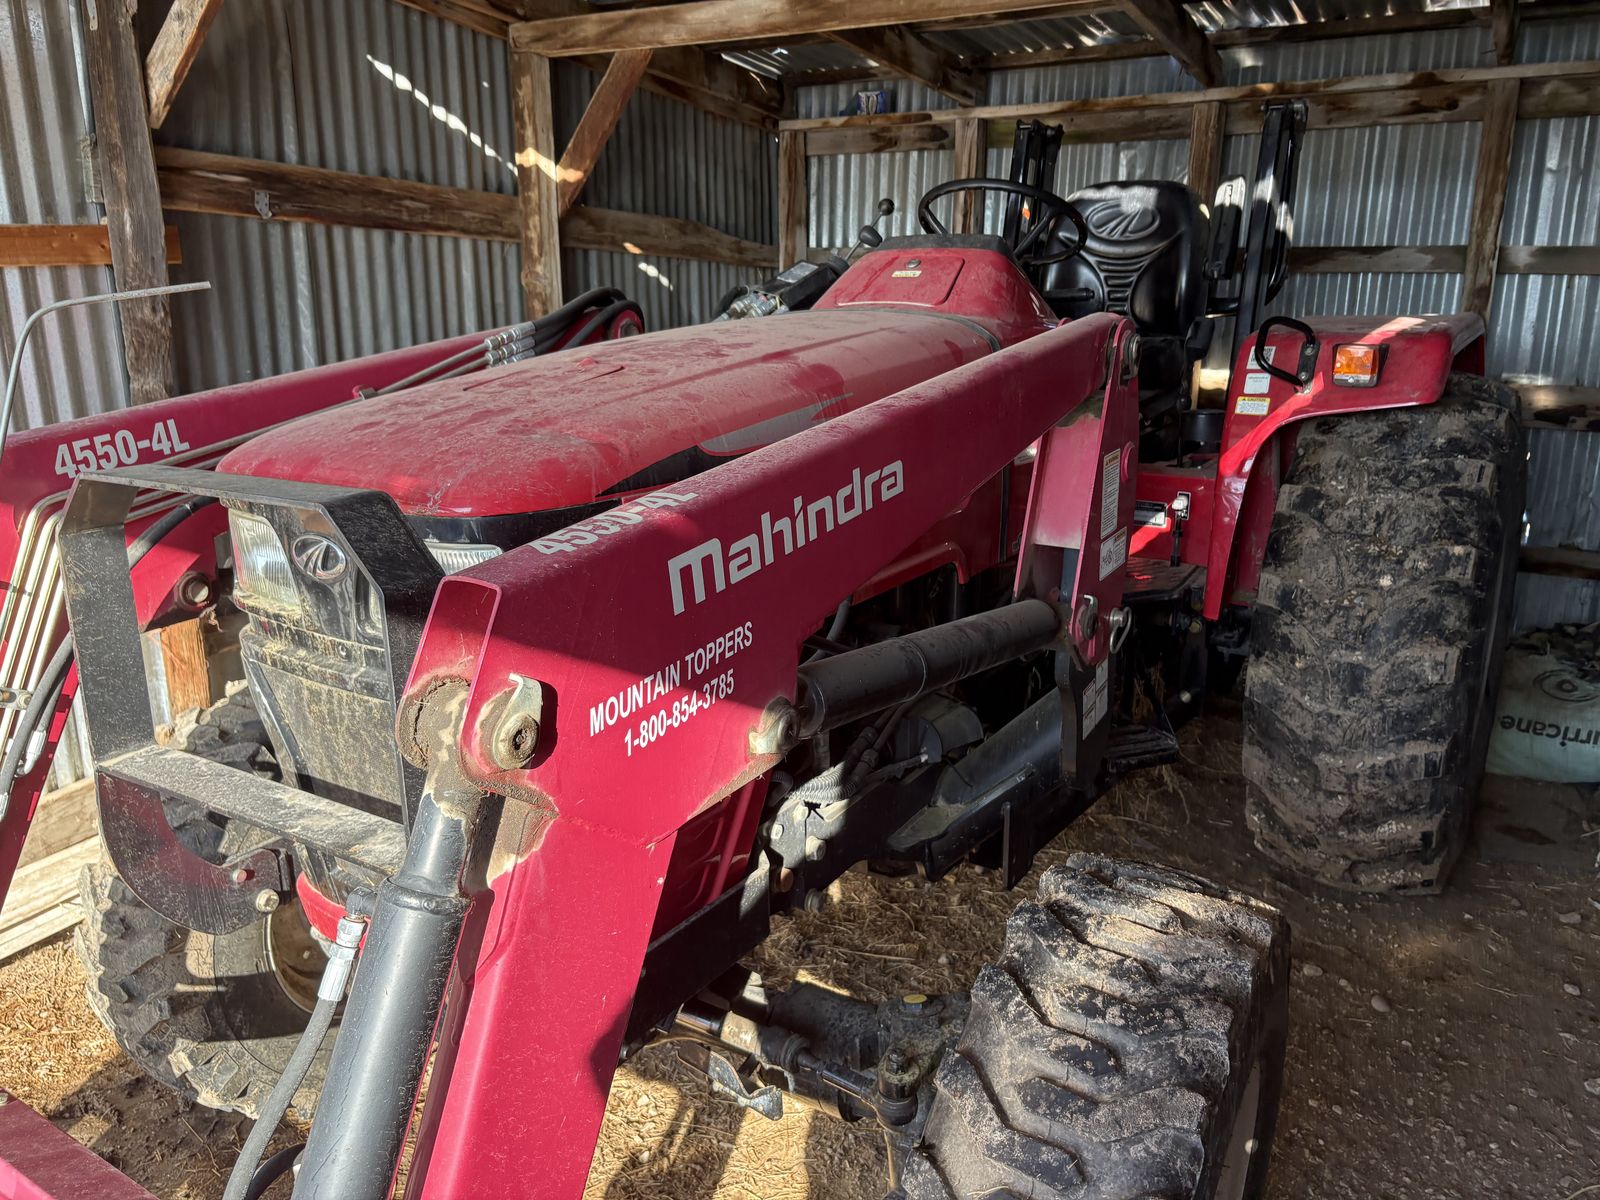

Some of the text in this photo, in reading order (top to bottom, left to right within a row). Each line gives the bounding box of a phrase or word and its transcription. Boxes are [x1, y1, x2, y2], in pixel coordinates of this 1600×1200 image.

[54, 418, 190, 479] 4550-4L
[667, 459, 904, 616] Mahindra
[589, 620, 753, 737] MOUNTAIN TOPPERS
[624, 668, 735, 757] 1-800-854-3785
